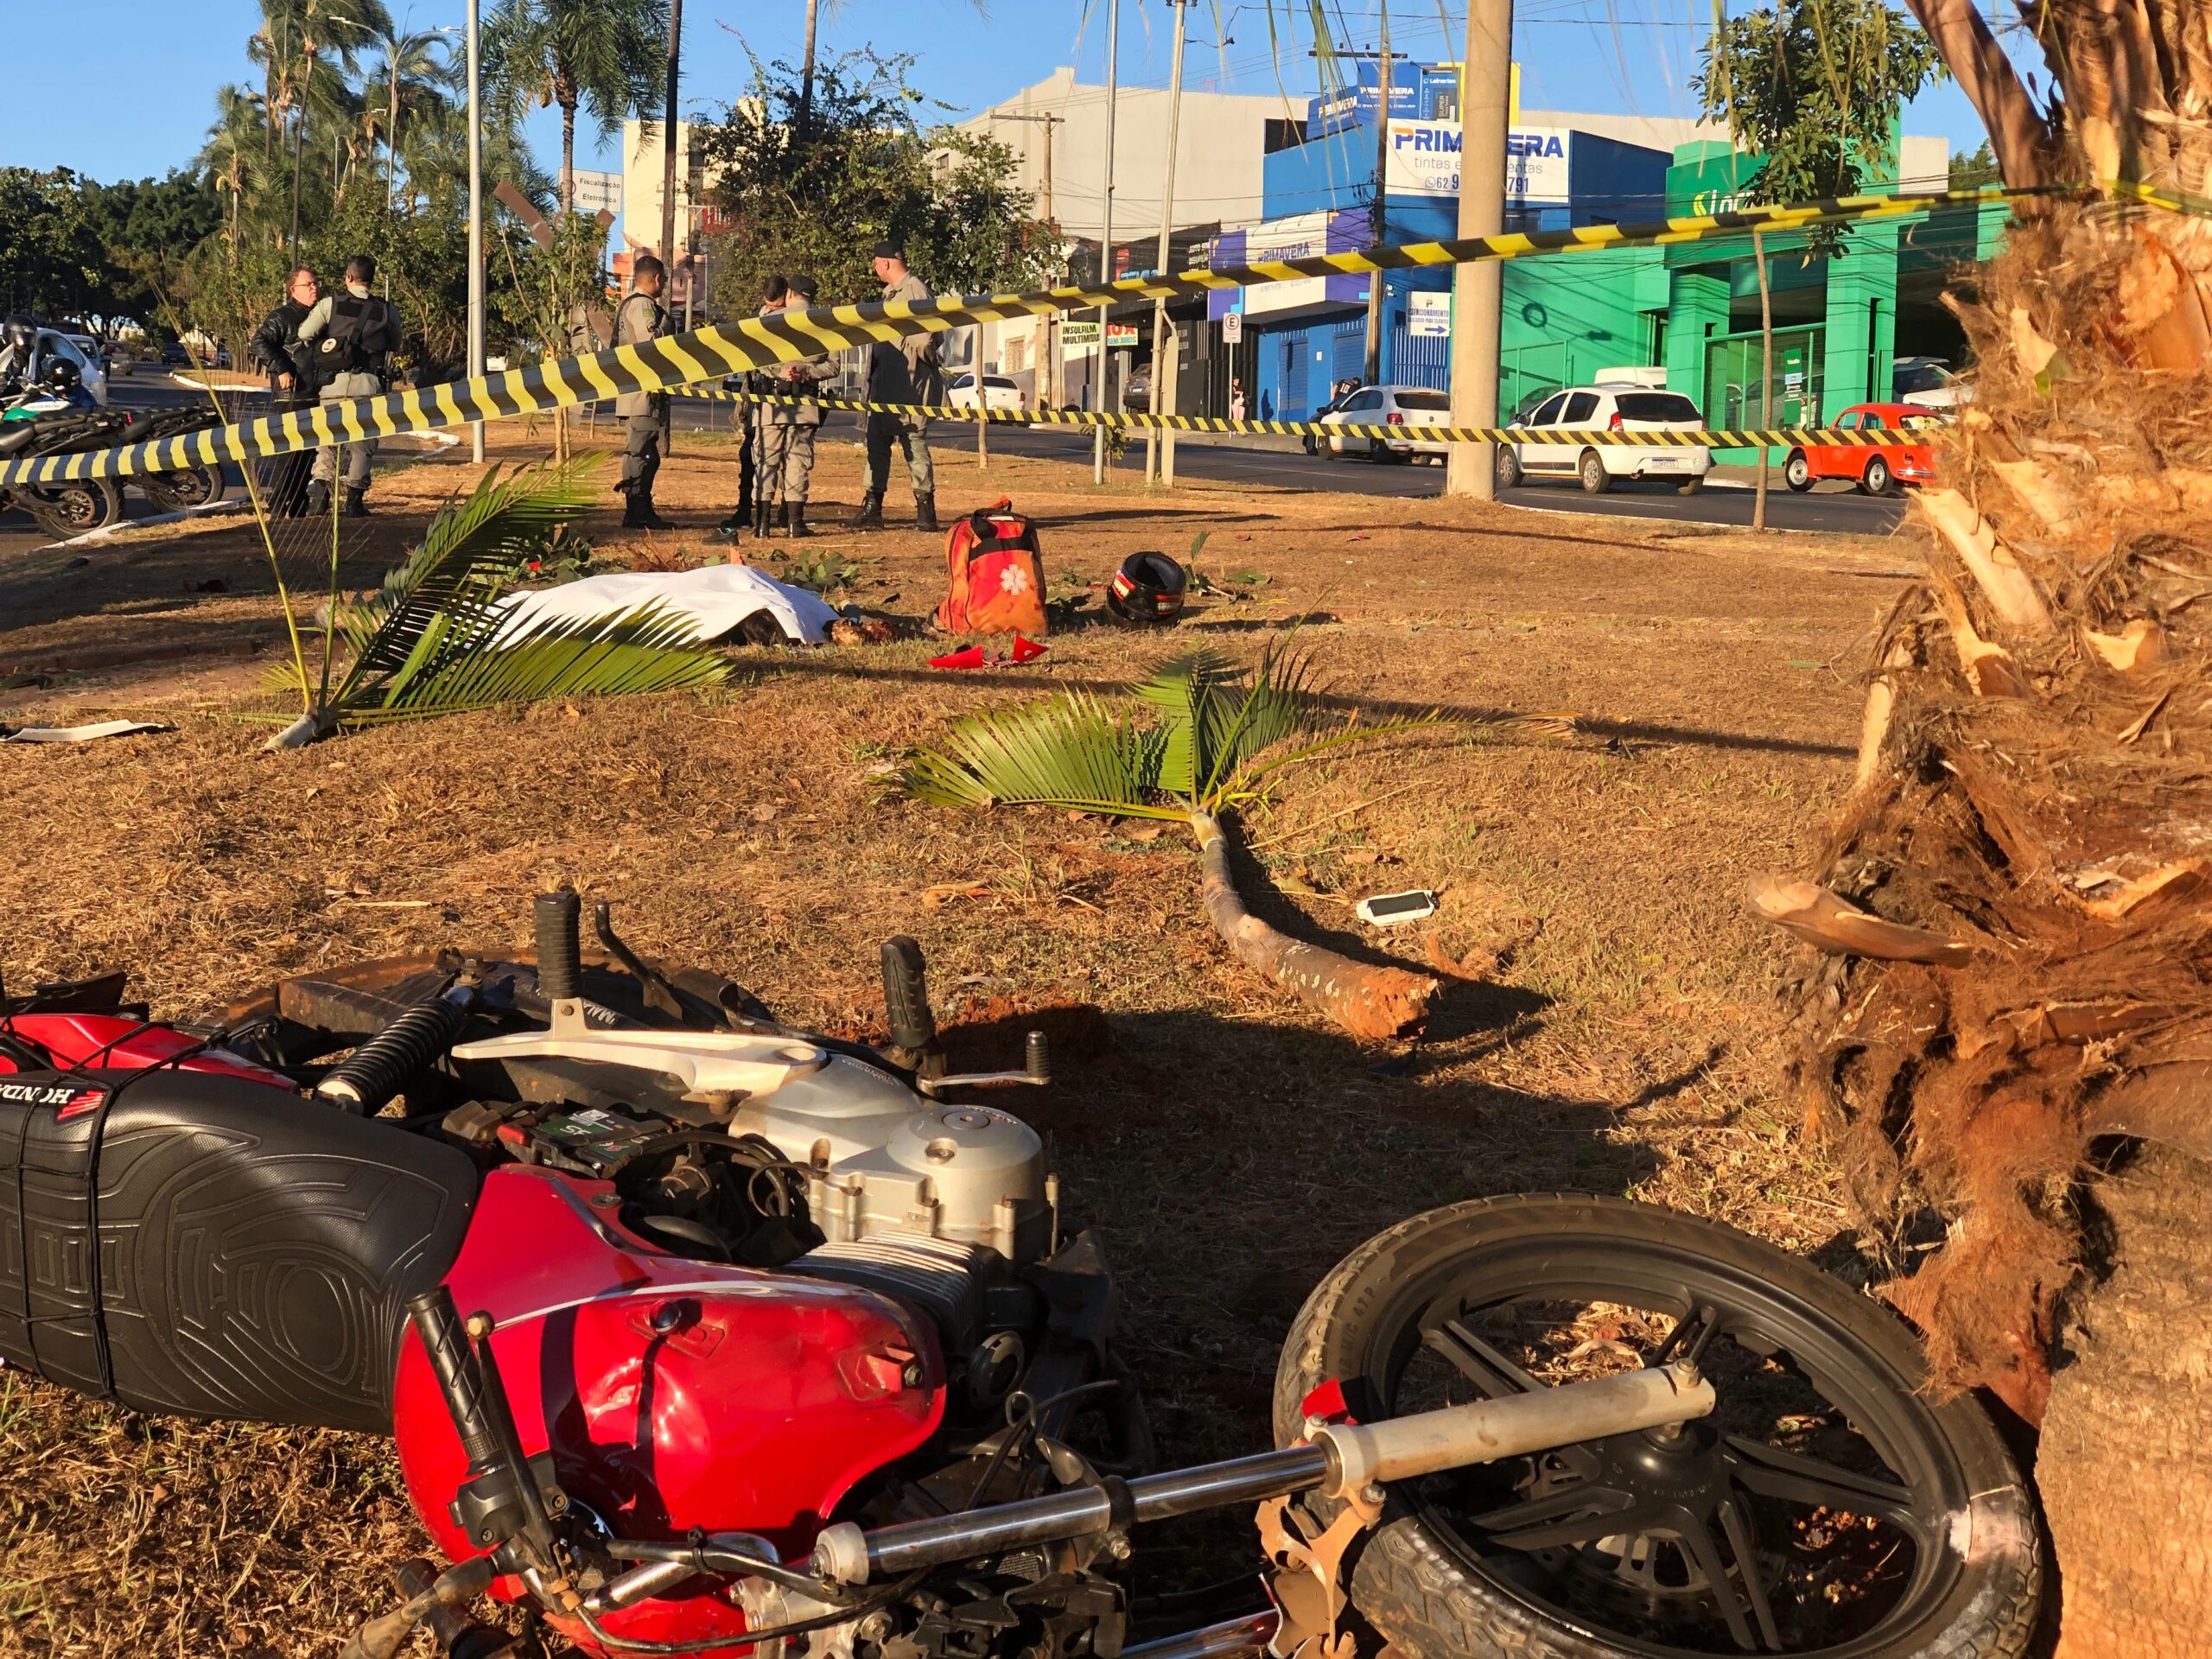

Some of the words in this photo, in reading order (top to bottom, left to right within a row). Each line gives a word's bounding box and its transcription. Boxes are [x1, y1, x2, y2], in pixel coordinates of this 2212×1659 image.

[1414, 156, 1451, 170] tintas
[1436, 176, 1449, 189] 62
[1230, 317, 1236, 327] E
[1062, 324, 1097, 335] INSULFILM
